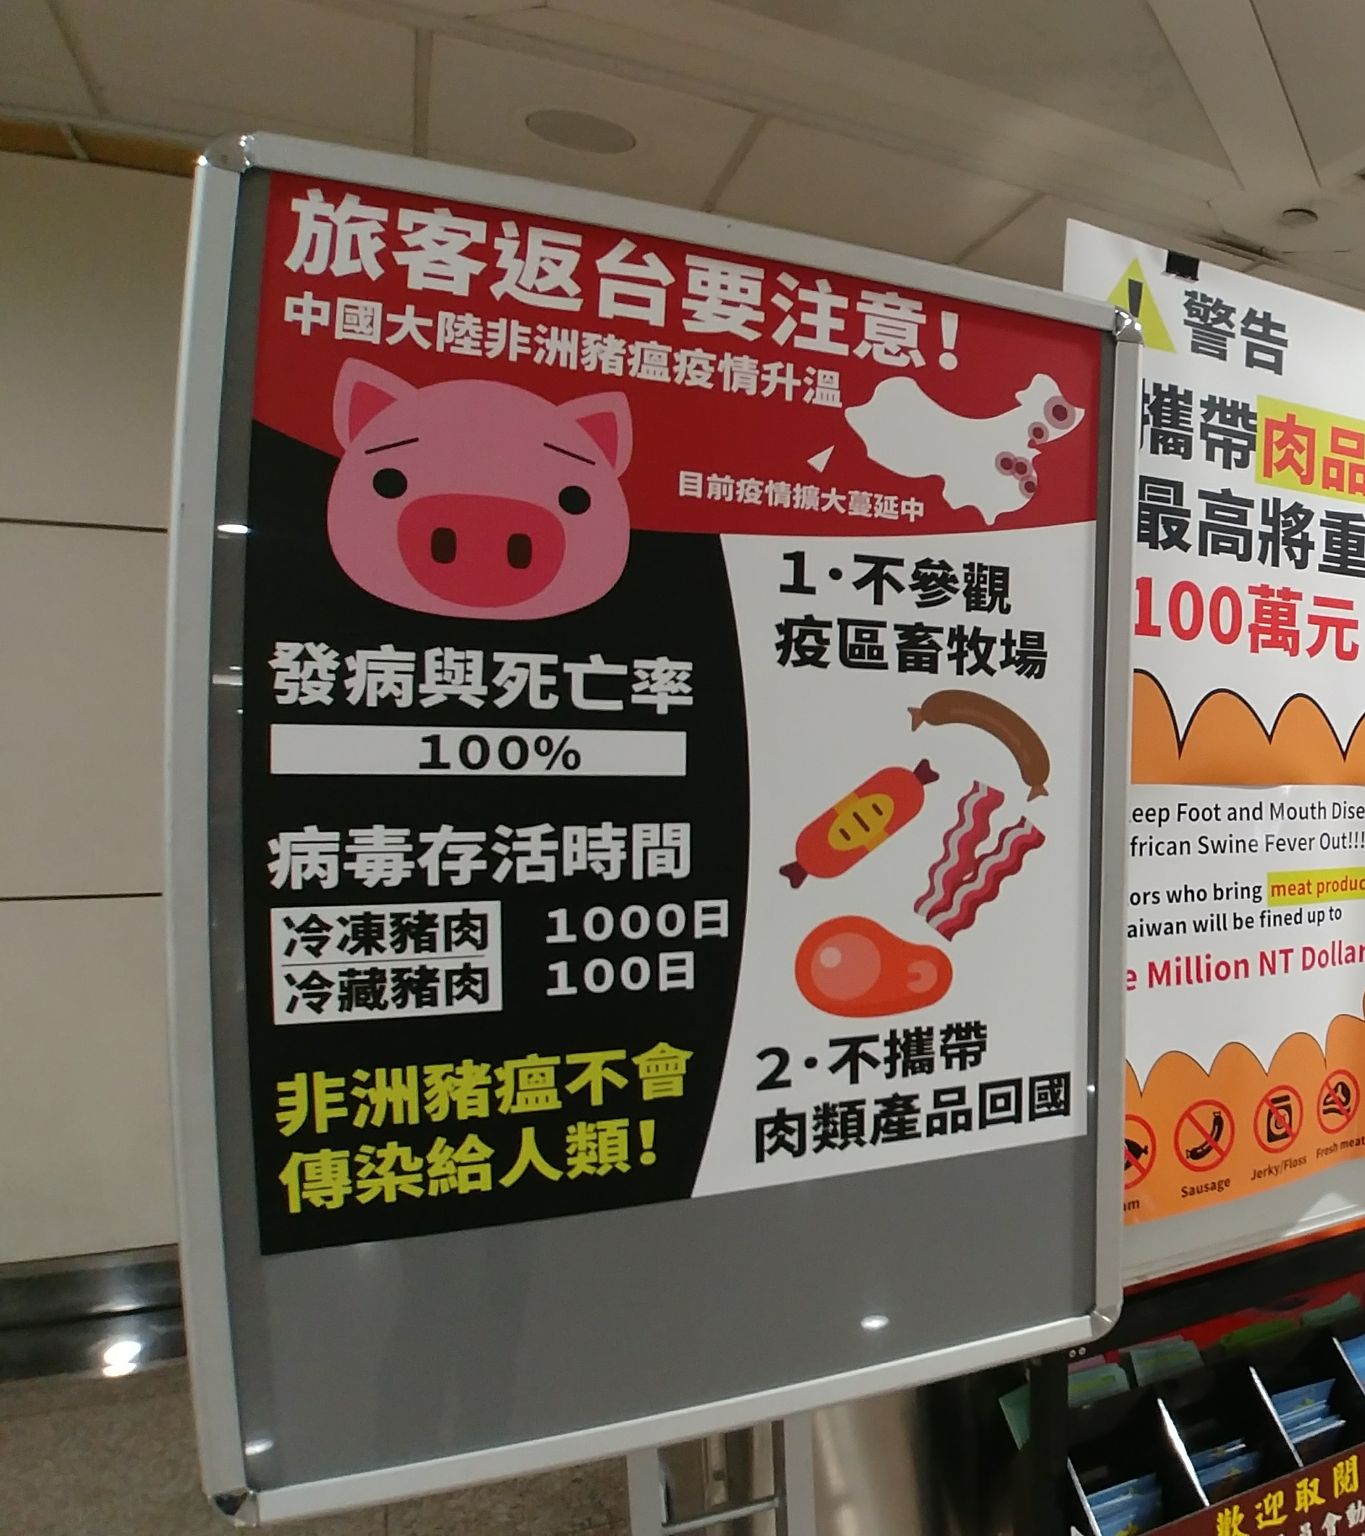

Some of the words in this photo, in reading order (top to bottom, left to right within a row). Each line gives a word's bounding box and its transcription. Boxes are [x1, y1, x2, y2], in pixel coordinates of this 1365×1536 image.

[283, 292, 843, 410] 中國大陸非洲豬瘟疫情升溫
[1183, 289, 1289, 376] 警告
[678, 470, 925, 524] 目前疫情擴大蔓延中
[1134, 575, 1361, 662] 100萬元
[775, 615, 1048, 681] 疫區畜牧場
[269, 640, 695, 716] 發病與死亡率
[418, 732, 582, 773] 100%
[1129, 802, 1170, 828] eep
[1176, 803, 1222, 823] Foot
[1227, 802, 1263, 823] and
[1270, 801, 1327, 821] Mouth
[267, 821, 692, 890] 病毒存活時間
[1129, 834, 1191, 857] frican
[1197, 834, 1259, 855] Swine
[1265, 834, 1316, 853] Fever
[1319, 831, 1365, 851] Out!!!
[1166, 884, 1208, 904] who
[1213, 881, 1262, 903] bring
[1271, 878, 1312, 898] meat
[281, 910, 489, 960] 冷凍豬肉
[545, 898, 731, 946] 1000日
[1127, 918, 1187, 939] aiwan
[1193, 913, 1227, 933] will
[1233, 912, 1254, 930] be
[1260, 907, 1302, 928] fined
[1308, 909, 1325, 927] up
[1329, 905, 1342, 921] to
[283, 961, 490, 1016] 冷藏豬肉
[546, 950, 696, 997] 100日
[1148, 953, 1250, 989] Million
[1259, 948, 1294, 977] NT
[274, 1041, 694, 1138] 非洲豬瘟不會
[754, 1070, 1072, 1163] 肉類產品回國
[278, 1118, 658, 1214] 傳染給人類!
[1250, 1155, 1308, 1181] Jerky/Floss
[1316, 1142, 1338, 1159] Fresh
[1340, 1136, 1365, 1153] meat
[1180, 1177, 1231, 1198] Sausage
